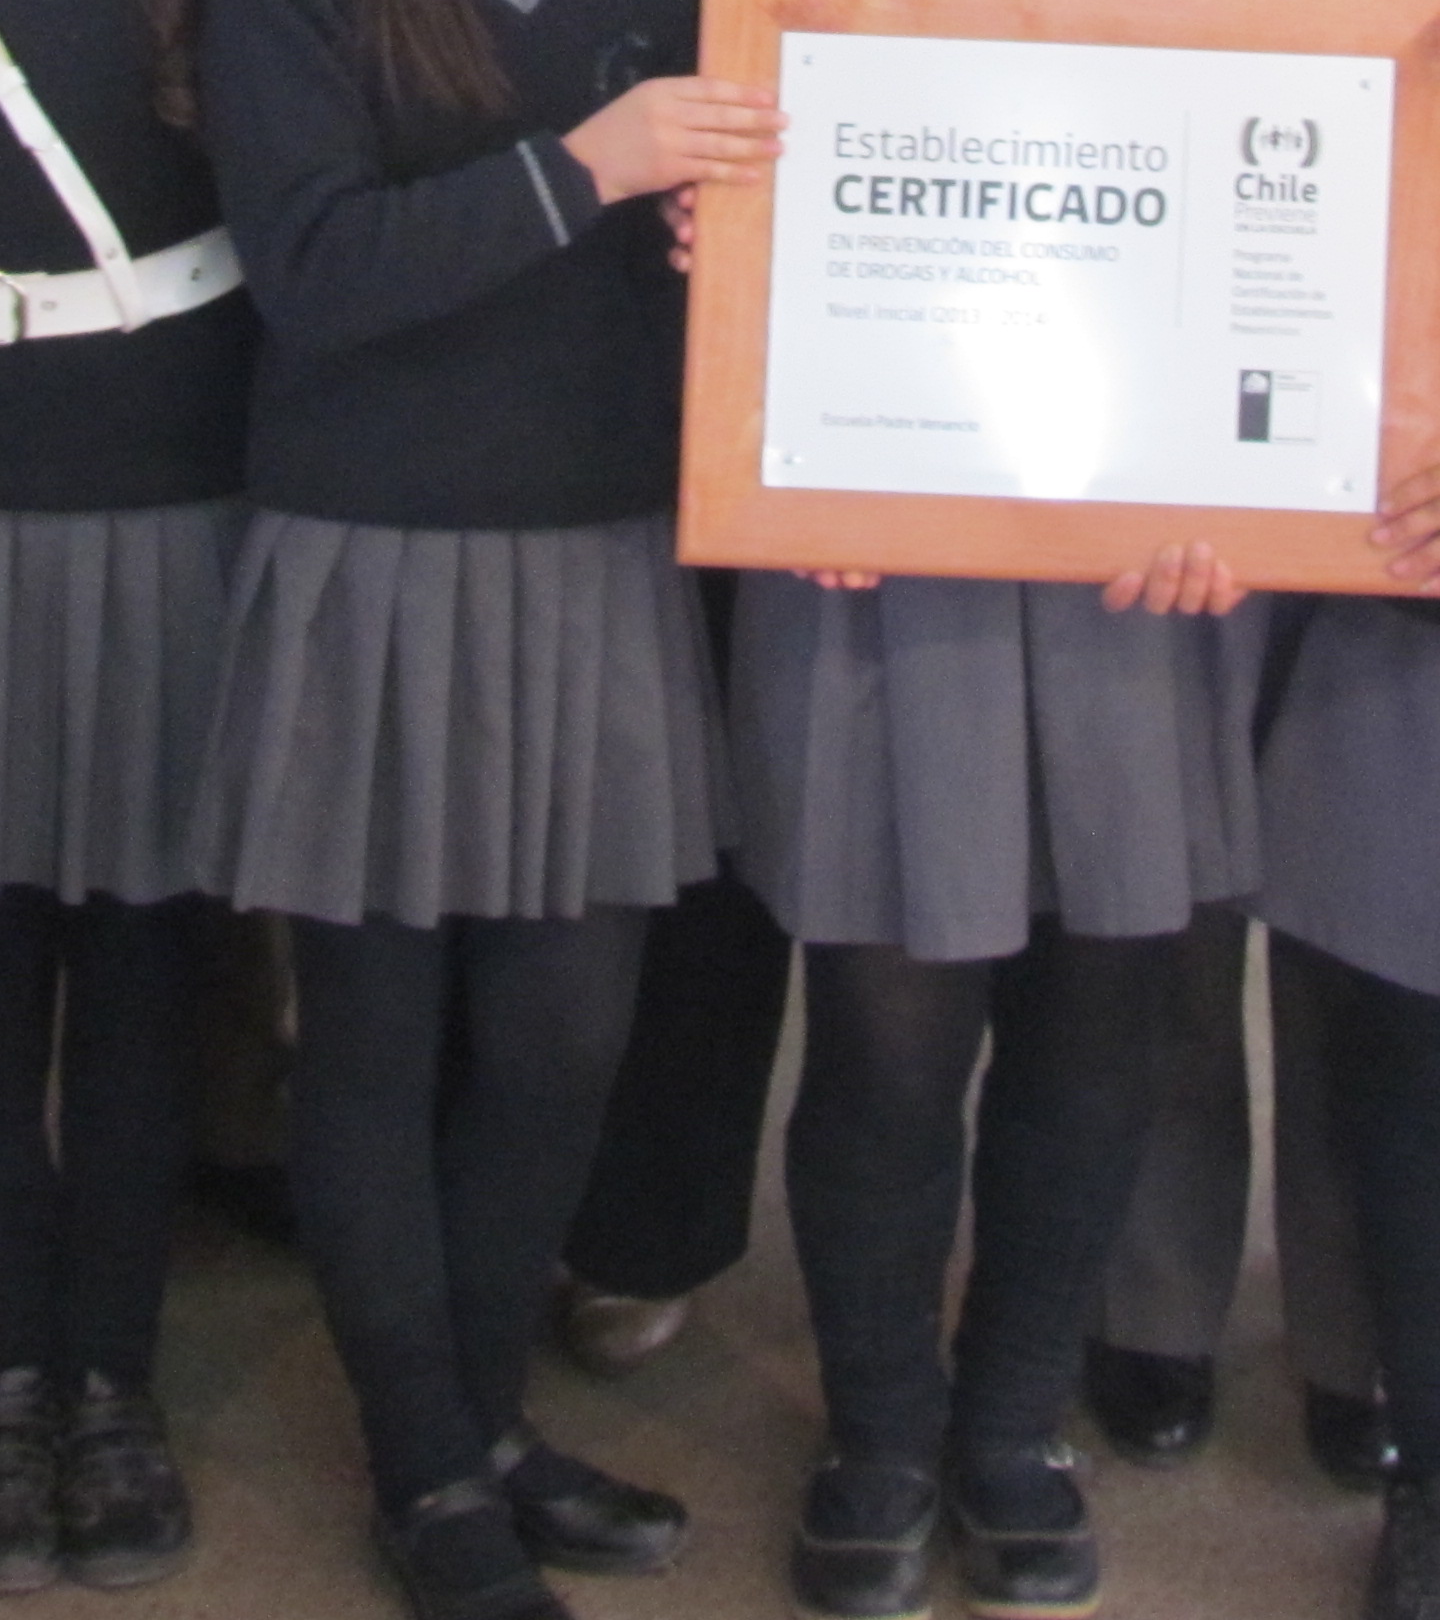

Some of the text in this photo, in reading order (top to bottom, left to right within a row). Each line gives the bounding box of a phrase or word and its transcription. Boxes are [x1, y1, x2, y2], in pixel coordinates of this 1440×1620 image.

[834, 122, 1168, 173] Establecimiento
[833, 174, 1167, 226] CERTIFICADO
[1235, 173, 1318, 202] Chile
[826, 232, 853, 251] EN
[979, 240, 1014, 258] DEL
[1020, 242, 1120, 262] CONSUMO
[826, 261, 851, 278] DE
[856, 262, 935, 281] DROGAS
